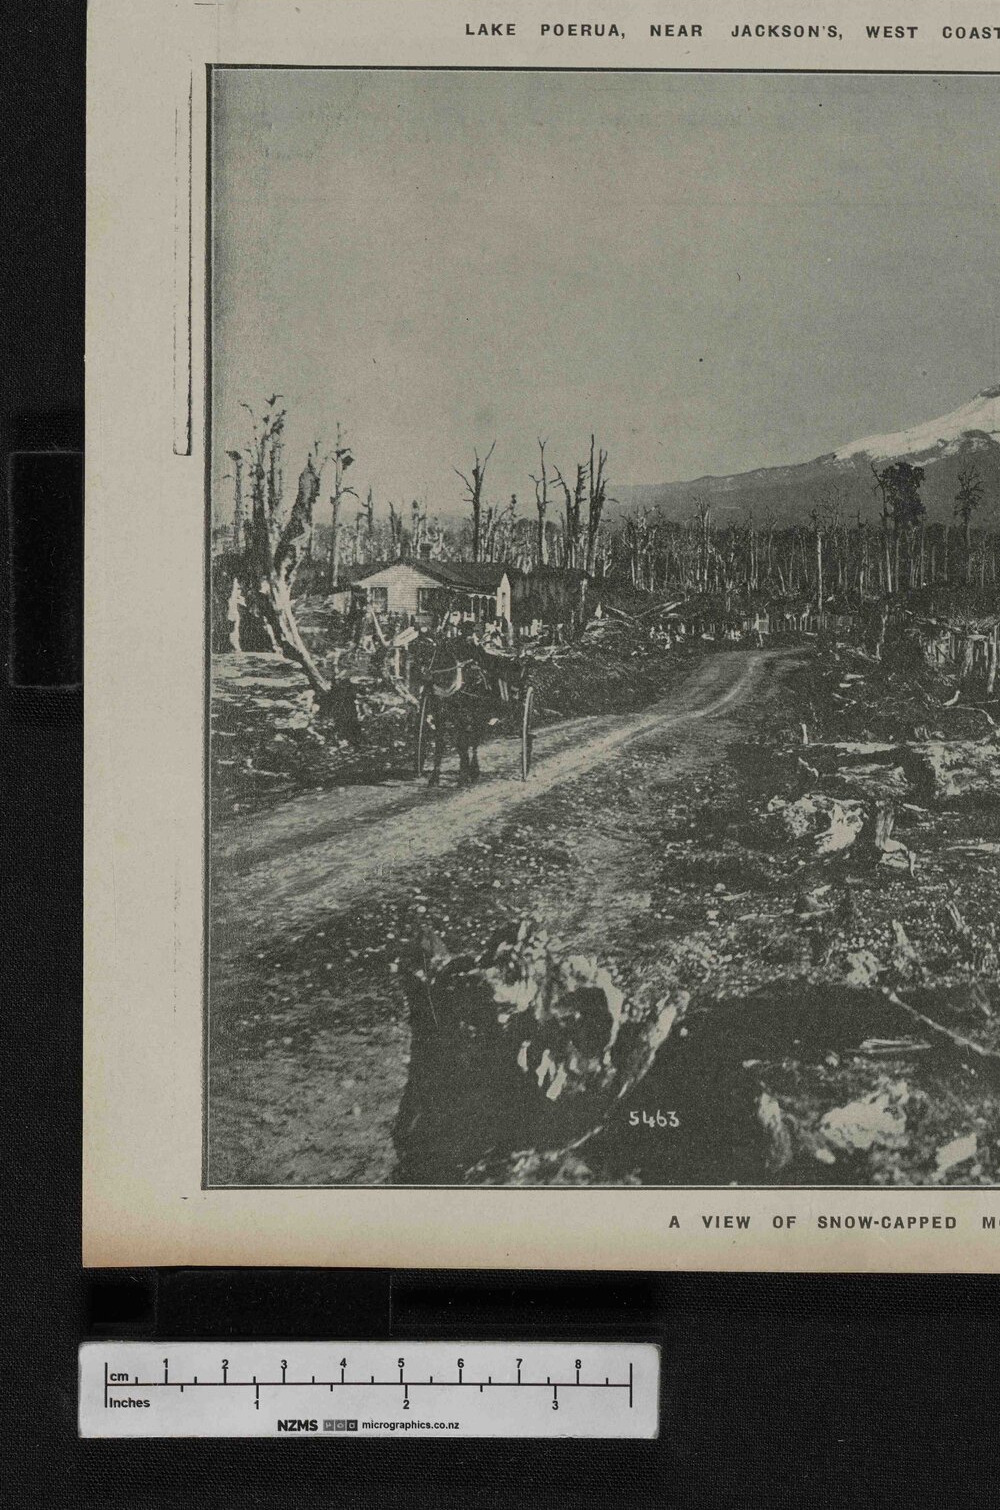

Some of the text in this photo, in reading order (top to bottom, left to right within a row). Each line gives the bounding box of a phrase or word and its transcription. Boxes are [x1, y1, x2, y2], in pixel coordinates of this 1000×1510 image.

[465, 23, 516, 36] LAKE
[540, 23, 625, 40] POERUA,
[650, 24, 703, 37] NEAR
[731, 24, 843, 40] JACKSON'S,
[865, 25, 919, 39] WEST
[628, 1109, 680, 1128] 5463
[668, 1215, 680, 1229] A
[701, 1215, 751, 1229] VIEW
[772, 1215, 797, 1229] OF
[817, 1215, 957, 1229] SNOW-CAPPED
[162, 1358, 582, 1370] 1 2 3 4 5 6 7 8
[109, 1373, 129, 1382] cm
[109, 1397, 151, 1408] Inches
[253, 1399, 559, 1411] 1 2 3
[277, 1419, 319, 1432] NZMS
[362, 1419, 460, 1432] micrographics.co.nz
